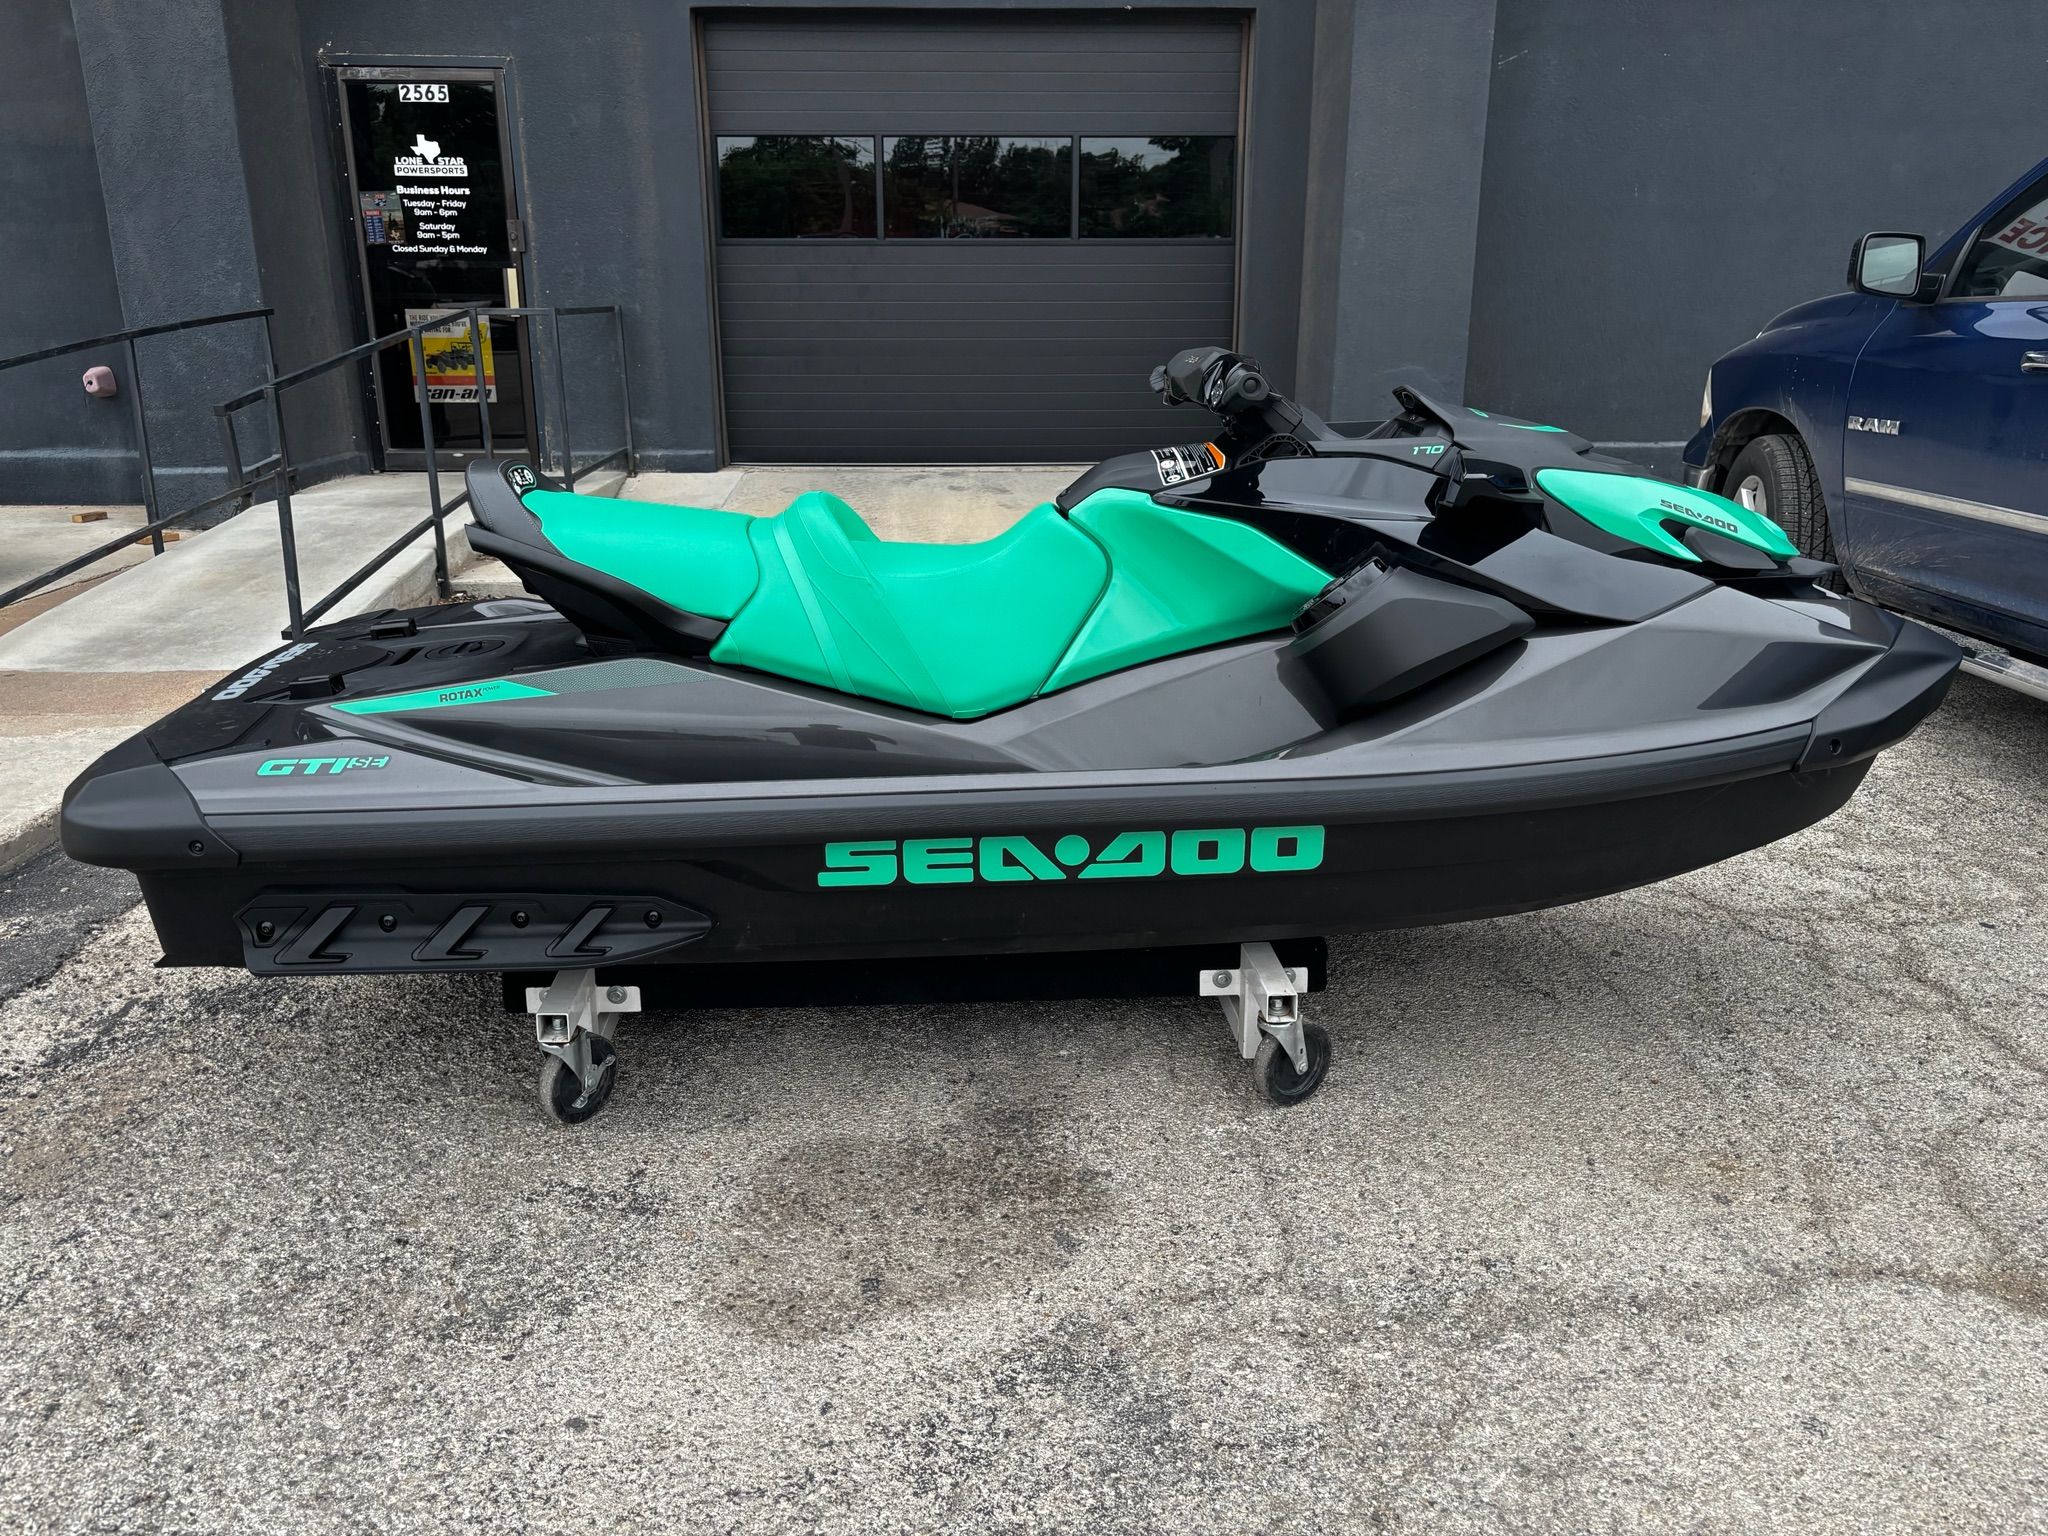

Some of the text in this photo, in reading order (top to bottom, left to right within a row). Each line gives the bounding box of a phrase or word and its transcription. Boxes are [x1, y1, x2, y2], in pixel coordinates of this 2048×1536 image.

[399, 85, 448, 102] 2565
[395, 156, 465, 165] LONE STAR
[396, 166, 466, 175] POWERSPORTS
[396, 185, 471, 195] Business Hours
[403, 199, 436, 209] Tuesday
[441, 199, 467, 210] Friday
[413, 208, 433, 217] 9am
[439, 208, 458, 218] 6pm
[419, 222, 456, 232] Saturday
[416, 231, 436, 239] 9am
[441, 231, 461, 241] 5pm
[392, 244, 488, 255] Closed Sunday & Monday
[1847, 415, 1901, 435] RAM
[1411, 445, 1445, 455] 170
[439, 687, 483, 703] ROTAX
[256, 757, 351, 776] GTI
